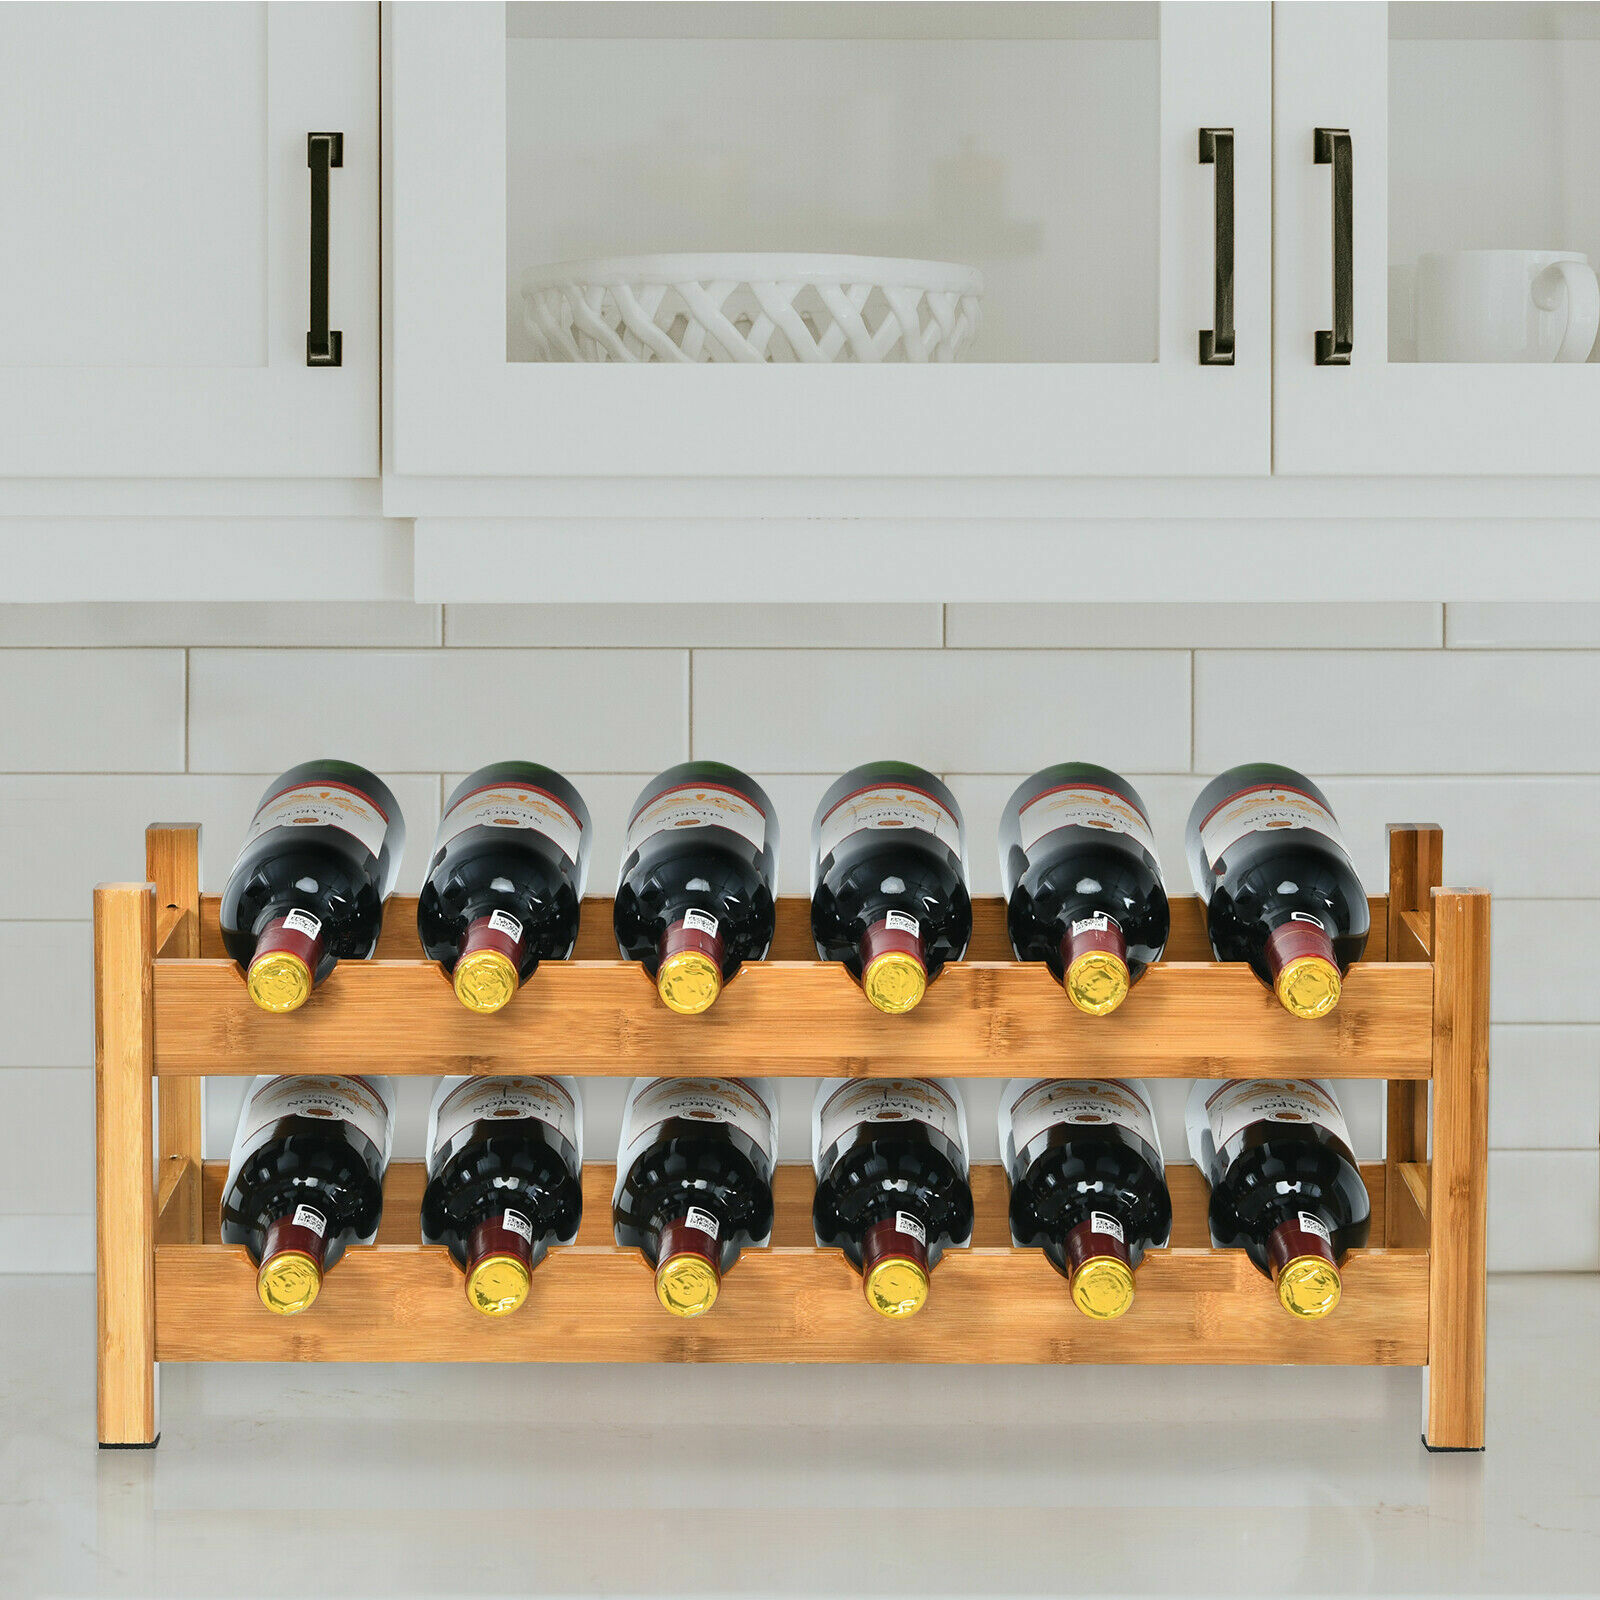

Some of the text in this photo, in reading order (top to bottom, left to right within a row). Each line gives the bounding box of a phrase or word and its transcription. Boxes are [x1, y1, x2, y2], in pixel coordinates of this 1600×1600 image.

[287, 1098, 354, 1115] SHARON
[473, 1099, 541, 1113] SHARON
[669, 1101, 737, 1117] SHARON
[855, 1101, 924, 1116] SHARON
[1052, 1105, 1122, 1117] SHARON
[1252, 1102, 1321, 1117] SHARON
